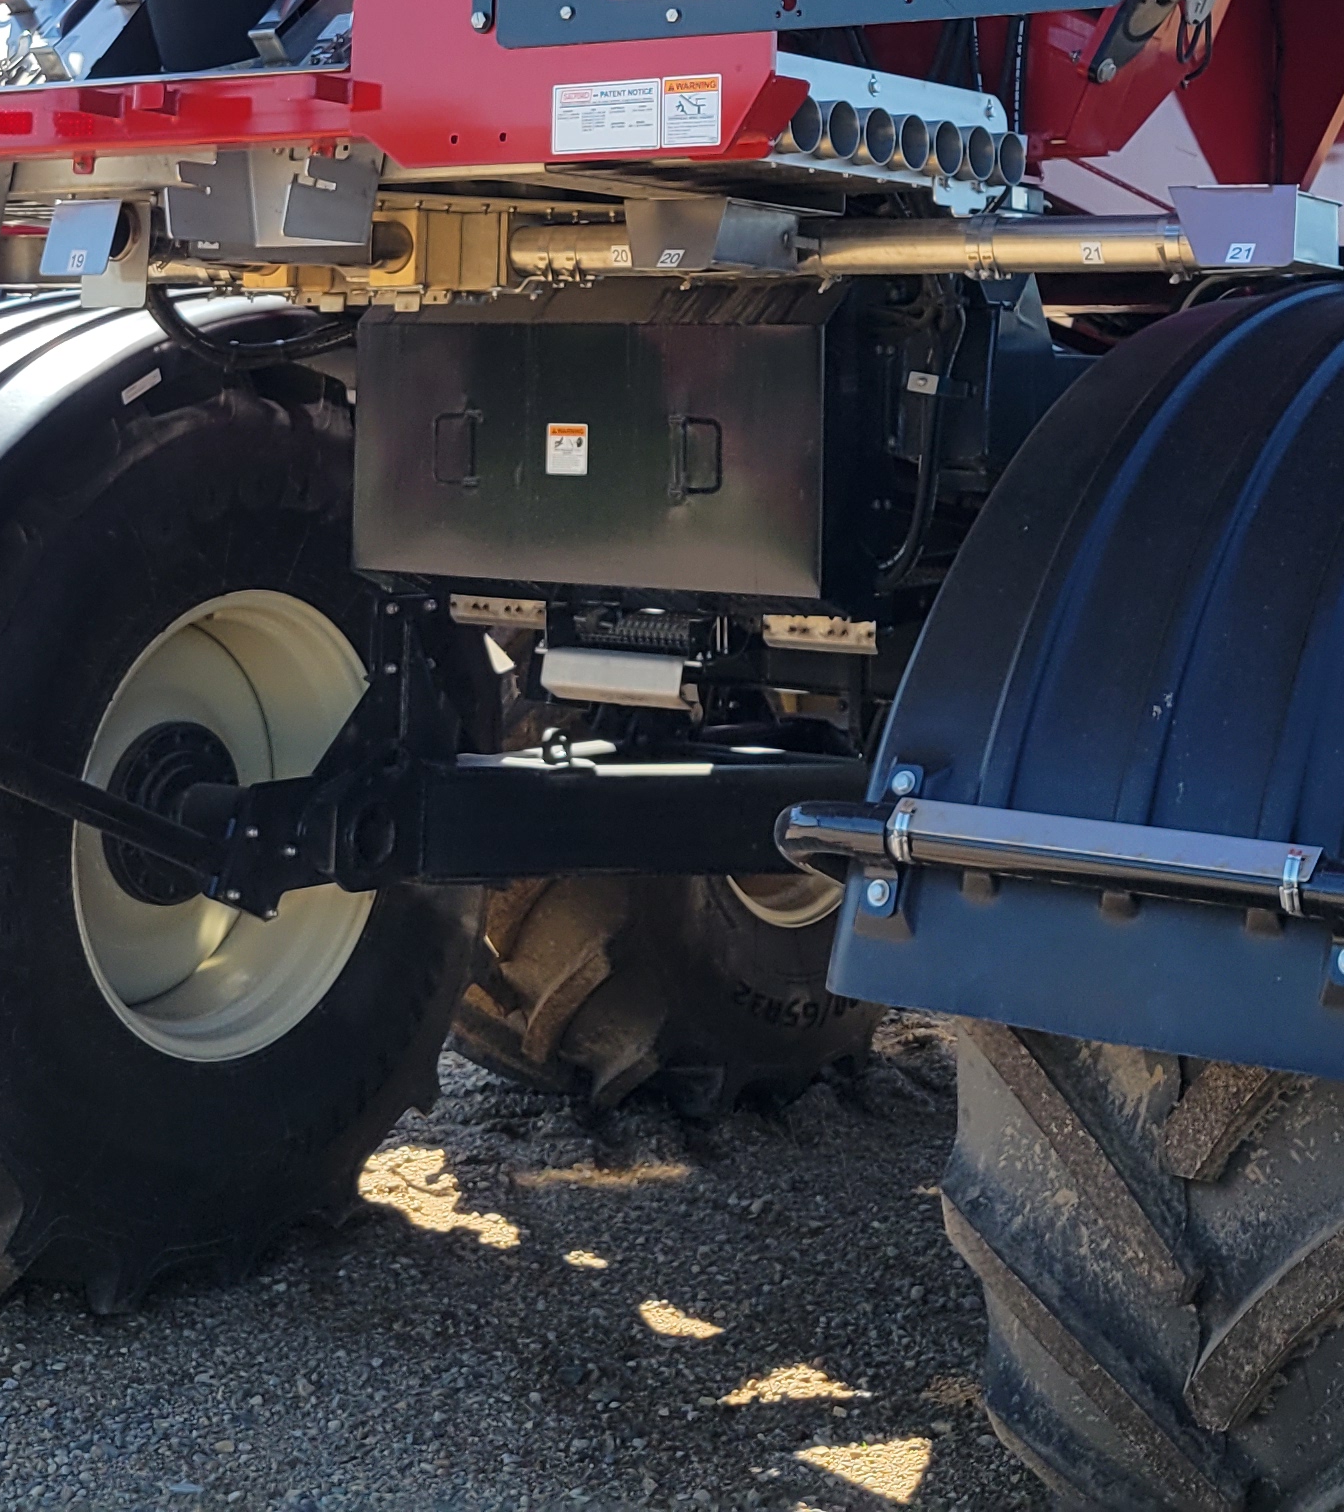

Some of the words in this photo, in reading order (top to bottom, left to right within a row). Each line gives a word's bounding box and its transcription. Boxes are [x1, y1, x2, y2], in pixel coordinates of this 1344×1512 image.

[675, 79, 717, 91] WARNING
[600, 90, 627, 99] PATENT
[627, 87, 654, 97] NOTICE
[612, 249, 629, 263] 20
[659, 252, 681, 264] 20
[1083, 246, 1102, 261] 21
[1229, 246, 1253, 260] 21
[71, 253, 85, 268] 19
[732, 979, 859, 1029] 0/65R32
